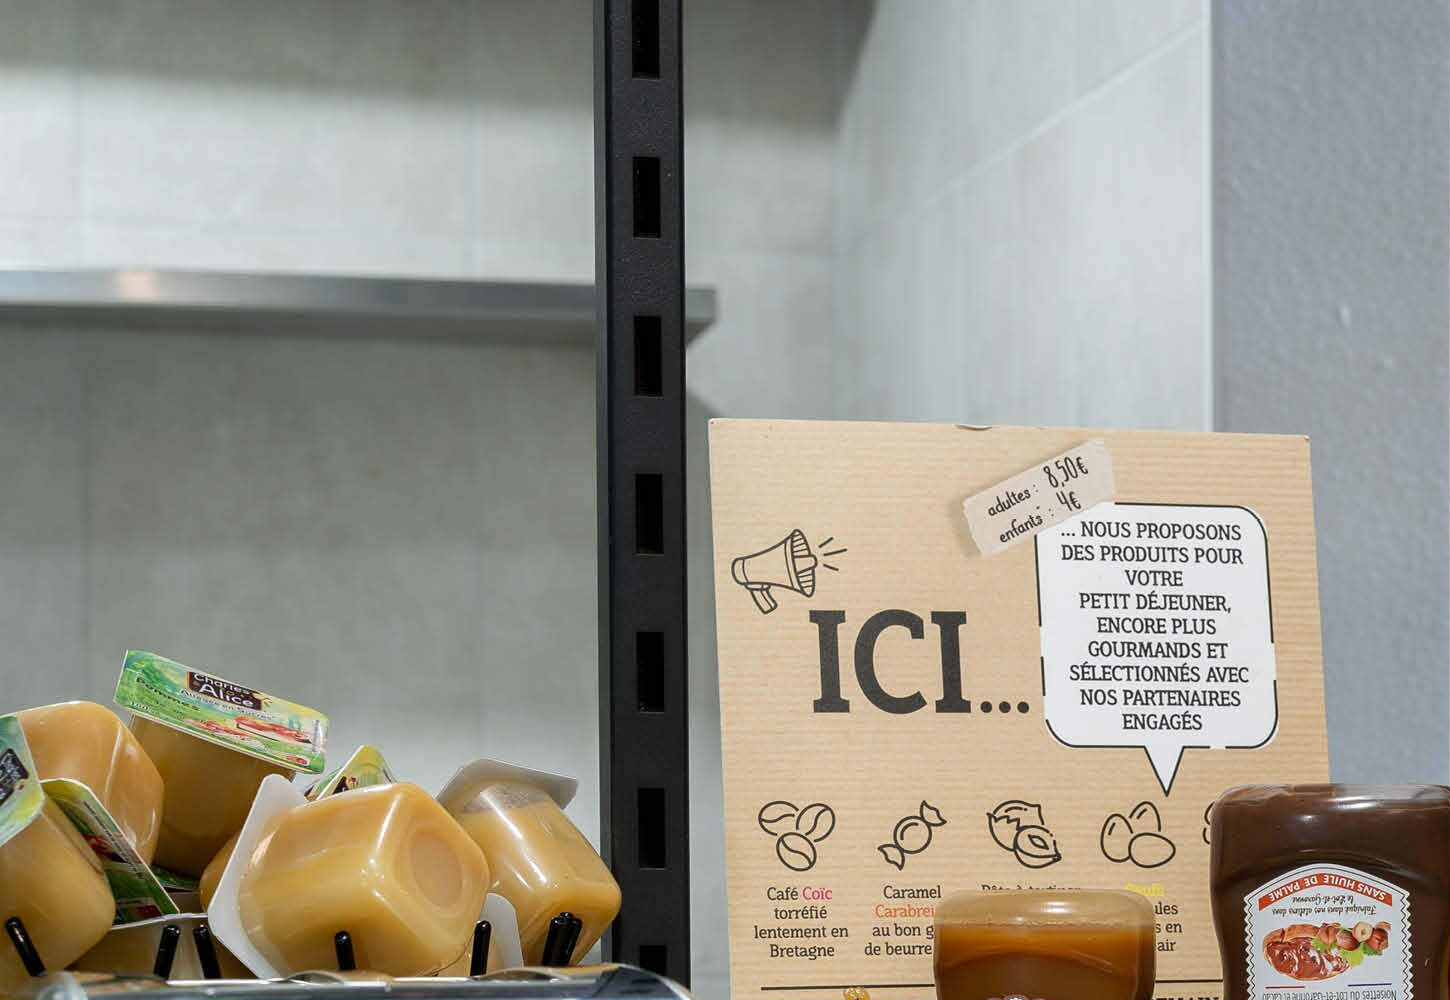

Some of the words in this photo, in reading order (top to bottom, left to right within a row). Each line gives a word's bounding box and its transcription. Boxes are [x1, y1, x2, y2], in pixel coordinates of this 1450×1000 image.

[988, 489, 1030, 516] adultes
[1043, 456, 1088, 488] 8,50€
[999, 515, 1042, 543] enfants
[1056, 491, 1081, 511] 4€
[1080, 521, 1131, 538] NOUS
[1136, 522, 1242, 541] PROPOSONS
[1061, 544, 1095, 561] DES
[1100, 545, 1189, 563] PRODUITS
[1194, 547, 1244, 565] POUR
[1124, 569, 1183, 586] VOTRE
[1079, 592, 1131, 609] PETIT
[1135, 590, 1231, 613] DÉJEUNER,
[1096, 616, 1167, 634] ENCORE
[1171, 617, 1217, 635] PLUS
[1088, 640, 1202, 659] GOURMANDS
[1206, 642, 1228, 659] ET
[808, 609, 1030, 715] ICI...
[1069, 661, 1201, 682] SÉLECTIONNÉS
[1205, 666, 1250, 683] AVEC
[199, 683, 255, 708] Alice
[1080, 688, 1118, 705] NOS
[1121, 689, 1242, 707] PARTENAIRES
[1121, 710, 1203, 730] ENGAGÉS
[1304, 876, 1318, 886] DE
[1323, 874, 1356, 889] HUILE
[766, 886, 799, 901] Café
[802, 886, 833, 900] Coïc
[883, 885, 942, 899] Caramel
[1268, 881, 1300, 900] PALME
[1357, 883, 1387, 900] SANS
[773, 905, 828, 920] torréfié
[874, 903, 935, 918] Carabrei
[753, 925, 827, 939] lentement
[830, 927, 849, 938] en
[872, 926, 891, 937] au
[894, 923, 921, 937] bon
[1165, 922, 1183, 934] en
[769, 943, 835, 961] Bretagne
[864, 942, 881, 956] de
[884, 942, 933, 956] beurre
[1157, 939, 1177, 952] air
